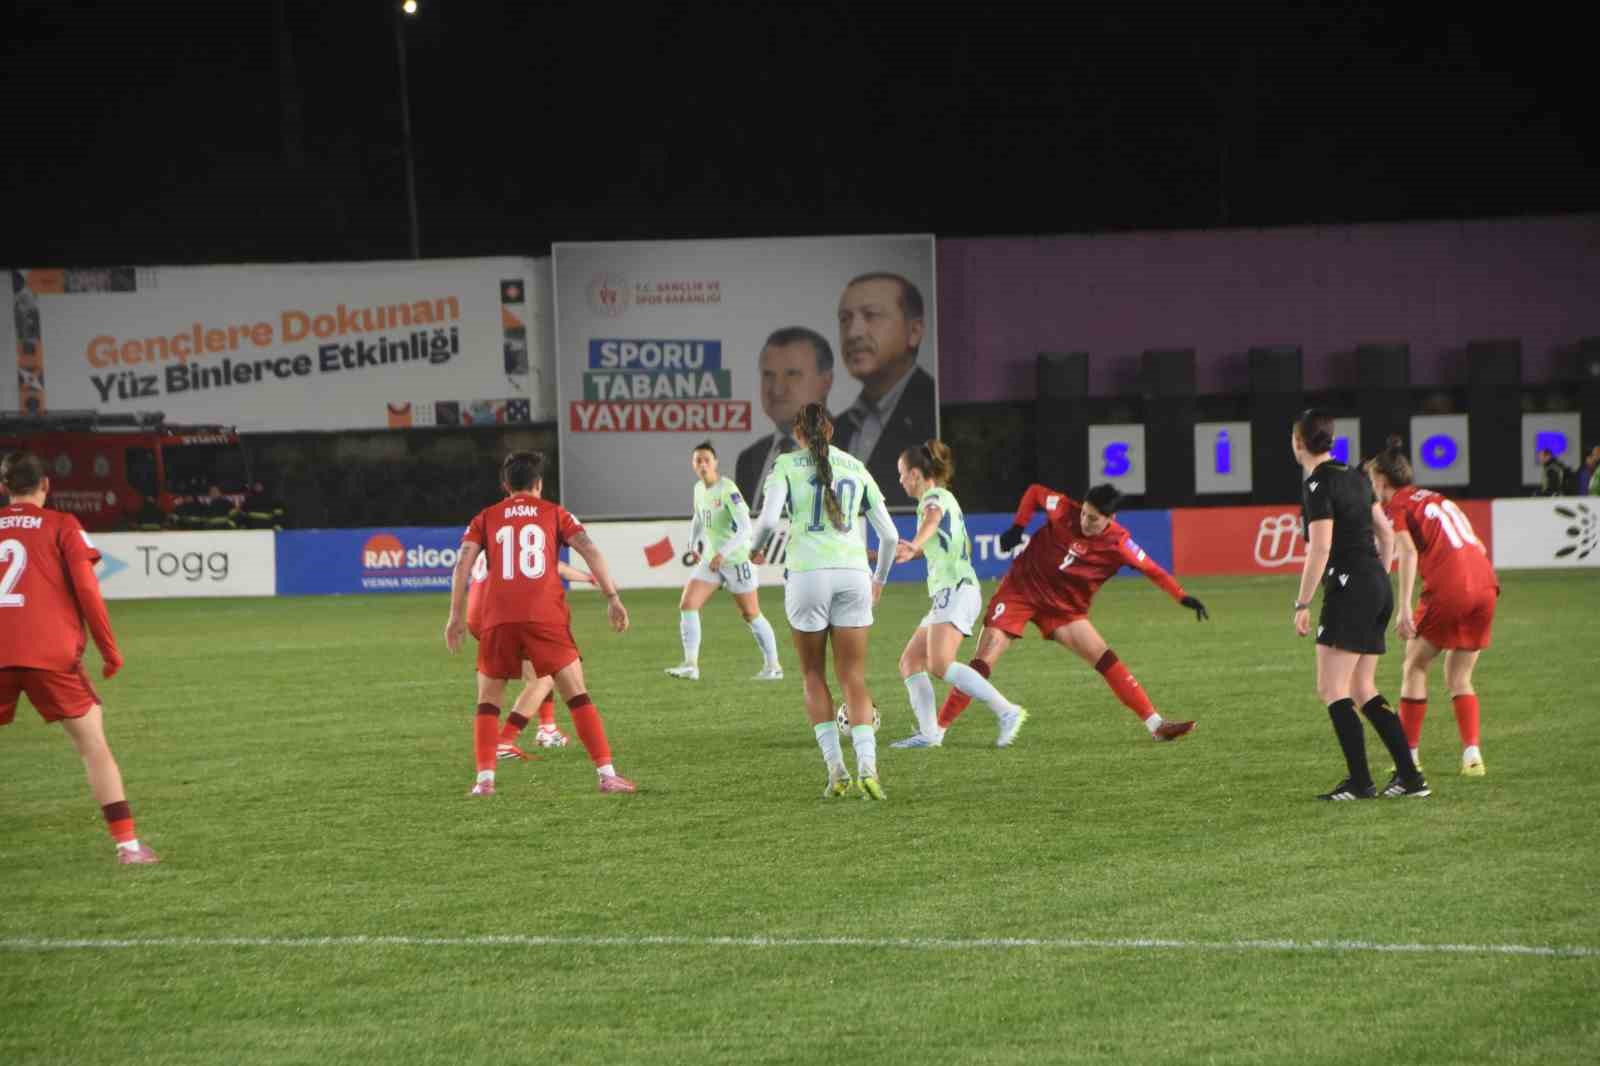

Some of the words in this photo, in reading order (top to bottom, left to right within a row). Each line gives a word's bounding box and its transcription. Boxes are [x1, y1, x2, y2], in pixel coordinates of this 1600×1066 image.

[86, 321, 273, 368] Gençlere
[279, 295, 461, 343] Dokunan
[90, 372, 160, 404] Yüz
[165, 354, 312, 395] Binlerce
[318, 326, 460, 374] Etkinliği
[599, 341, 705, 368] SPORU
[591, 371, 719, 399] TABANA
[575, 402, 747, 430] YAYIYORUZ
[805, 474, 857, 532] 10
[1424, 499, 1476, 549] 10
[136, 546, 229, 581] Togg
[364, 550, 404, 568] RAY
[406, 544, 459, 568] SİGO
[496, 523, 546, 580] 18
[401, 575, 452, 587] INSURANC
[734, 562, 752, 583] 18
[991, 603, 1006, 620] 9
